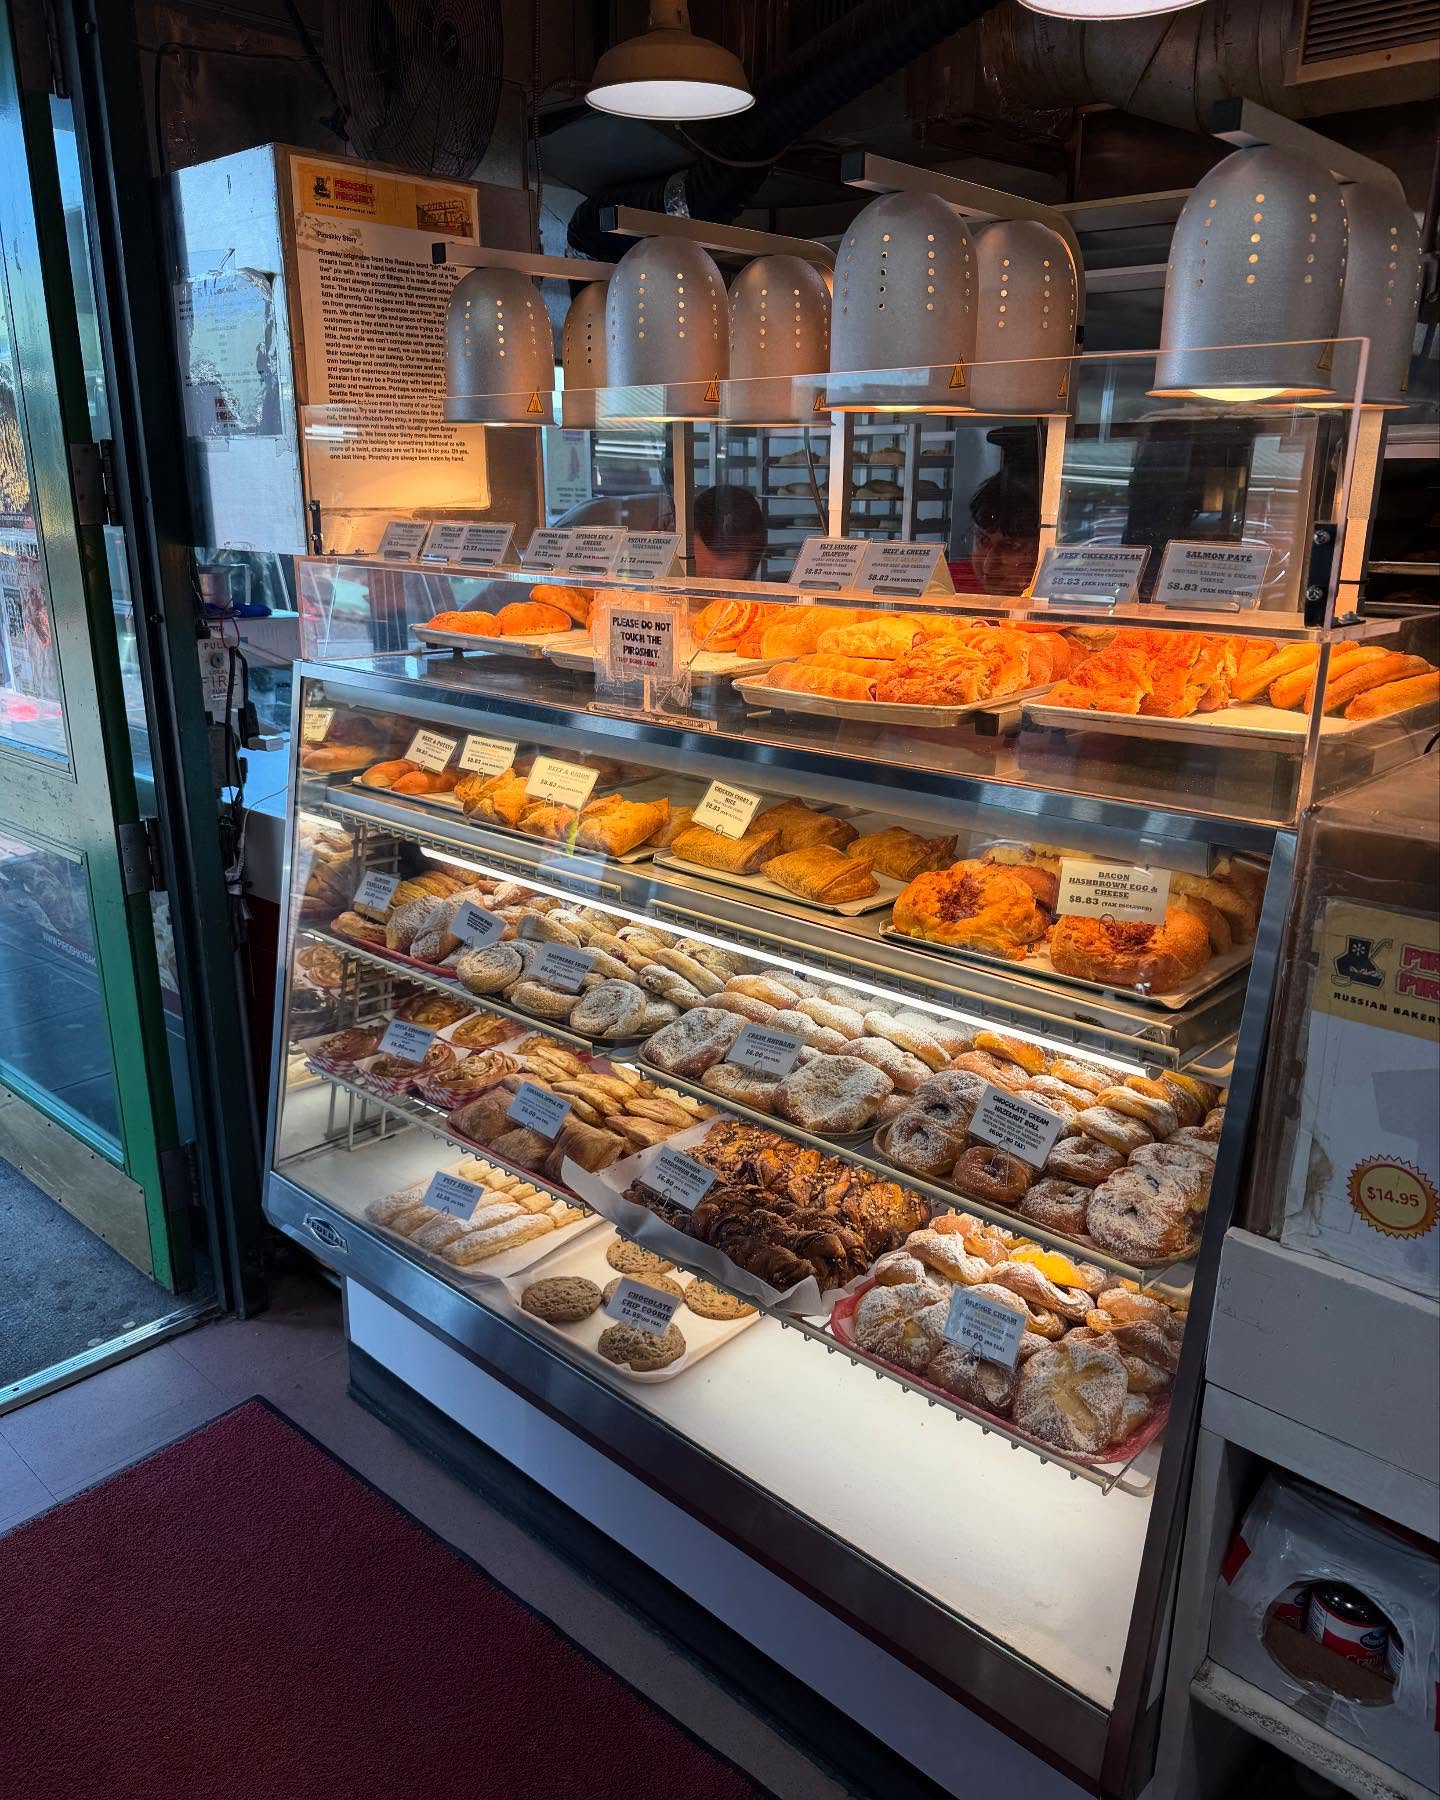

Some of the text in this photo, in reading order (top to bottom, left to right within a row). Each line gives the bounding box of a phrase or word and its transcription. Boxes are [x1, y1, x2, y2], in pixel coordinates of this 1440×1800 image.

[318, 230, 357, 244] Piroshky Story
[318, 248, 342, 258] Piroshky
[1186, 551, 1253, 562] SALMON PATÉ
[1052, 577, 1080, 585] $8.83
[1167, 582, 1198, 592] $8.83
[612, 617, 671, 632] PLEASE DO NOT
[621, 631, 662, 645] TOUCH THE
[623, 645, 660, 659] PIROSHKY.
[570, 771, 590, 780] ONION
[714, 786, 734, 797] CHICKEN
[1098, 872, 1130, 881] BACON
[1069, 877, 1128, 890] HASHBROWN
[1130, 884, 1149, 892] EGG
[1069, 895, 1099, 905] $8.83
[1094, 889, 1129, 898] CHEESE
[1334, 992, 1388, 1011] RUSSIAN
[767, 1037, 796, 1048] RHUBARB
[746, 1049, 763, 1058] $6.00
[992, 1095, 1049, 1126] CHOCOLATE CREAM
[994, 1105, 1040, 1132] HAZELNUT ROLL
[1004, 1135, 1013, 1144] (NO
[1014, 1140, 1026, 1150] TAX)
[674, 1156, 702, 1174] CINNAMON
[657, 1174, 674, 1186] $6.00
[1367, 1186, 1419, 1208] $14.95
[628, 1291, 672, 1312] CHOCOLATE
[622, 1298, 672, 1321] CHIP COOKIE
[622, 1308, 640, 1319] $2.95
[993, 1310, 1017, 1326] CREAM
[961, 1327, 983, 1342] $6.00
